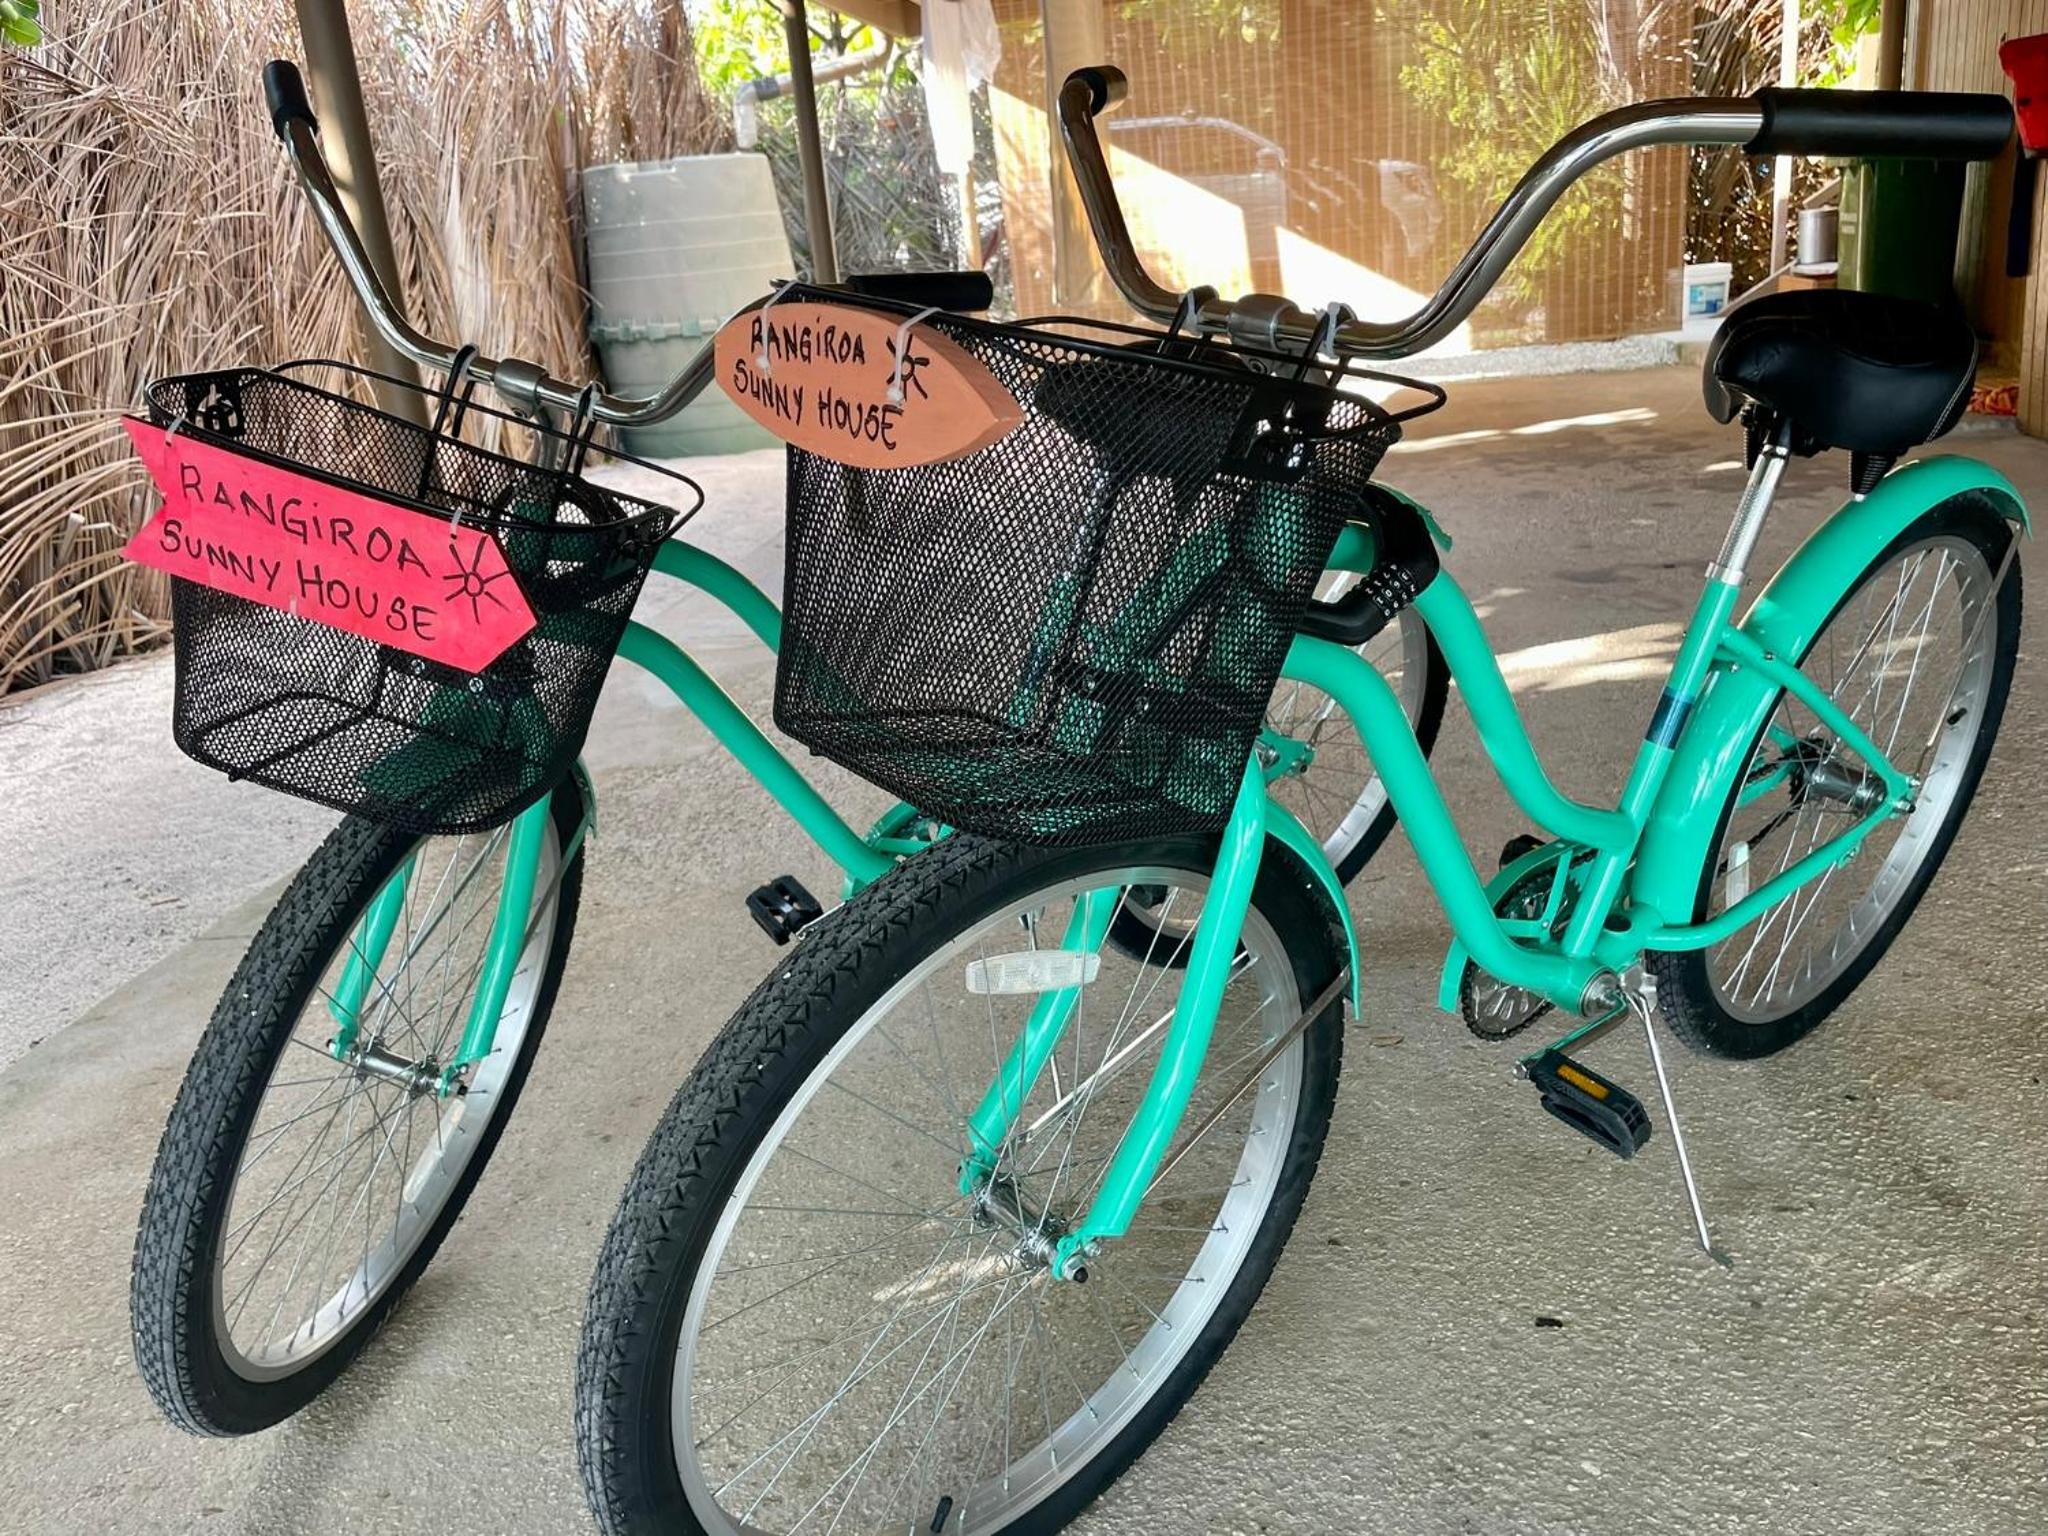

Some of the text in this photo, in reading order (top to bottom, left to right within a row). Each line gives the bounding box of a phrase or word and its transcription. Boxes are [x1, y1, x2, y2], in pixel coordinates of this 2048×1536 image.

[733, 358, 904, 450] SUNNY HOUSE
[159, 519, 439, 642] SUNNY HOUSE
